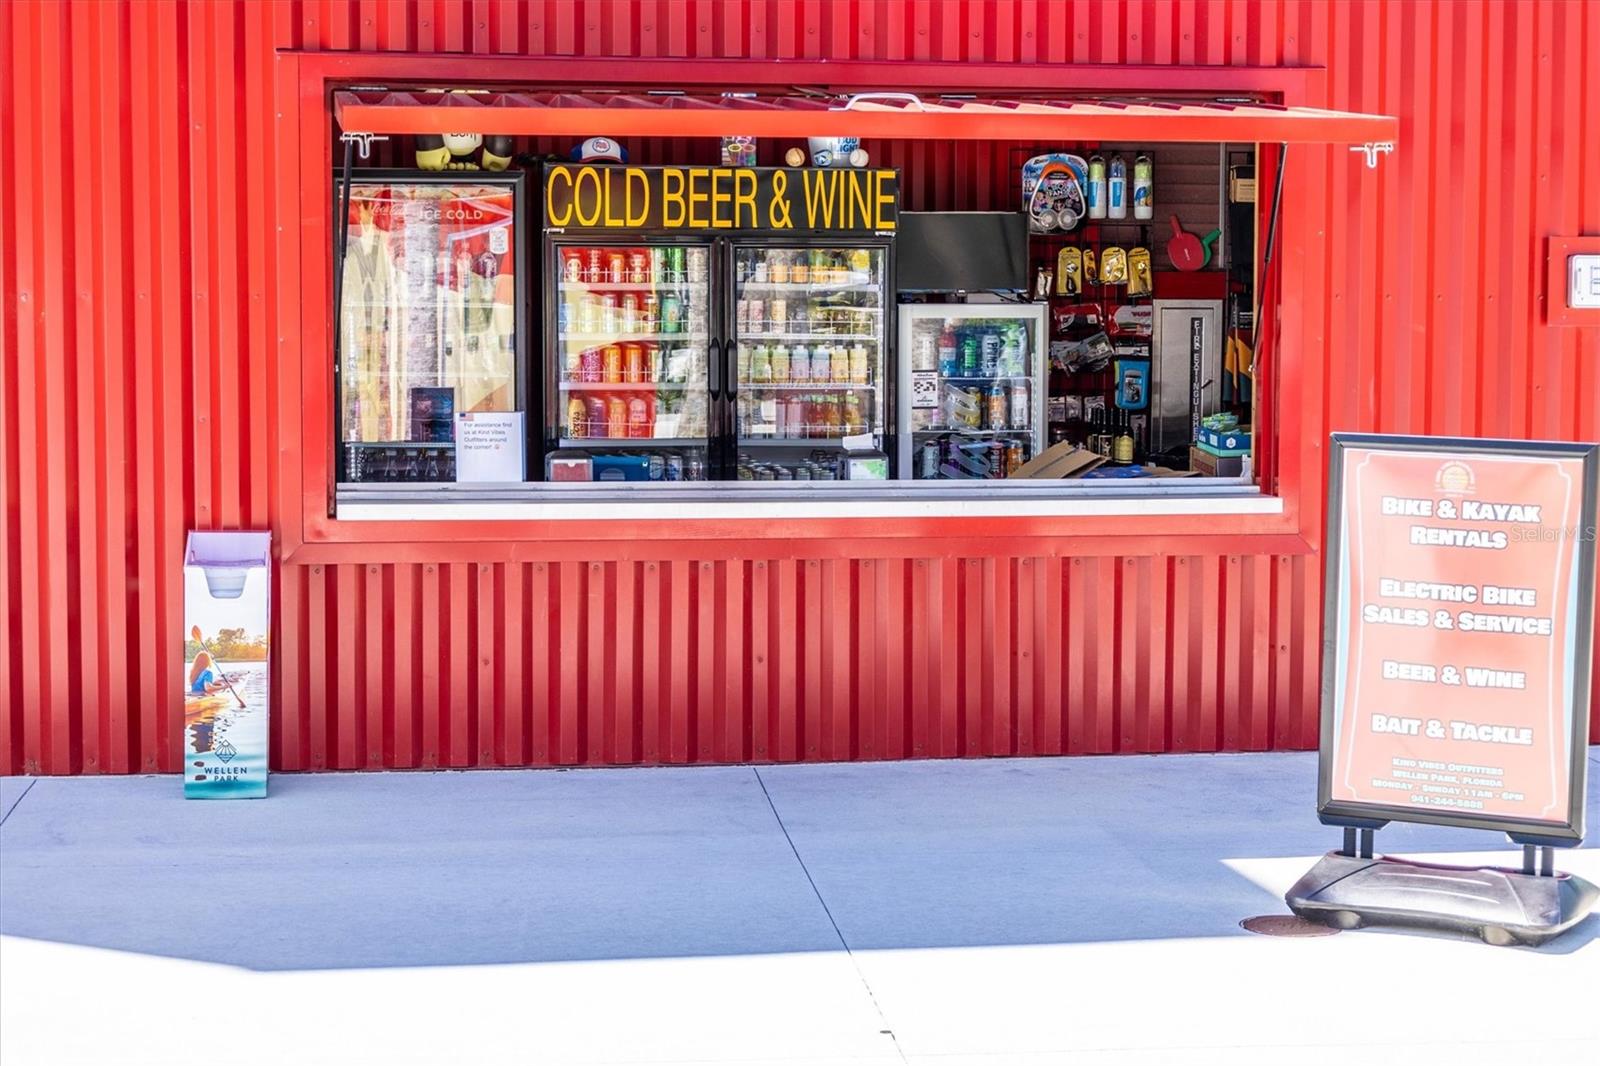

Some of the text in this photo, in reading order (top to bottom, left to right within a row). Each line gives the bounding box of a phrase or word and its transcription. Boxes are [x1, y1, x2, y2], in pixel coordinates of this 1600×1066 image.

[547, 166, 896, 230] COLD BEER & WINE
[420, 209, 483, 221] ICE COLD
[1381, 497, 1542, 523] BIKE & KAYAK
[1410, 526, 1508, 549] RENTALS
[1380, 578, 1536, 606] ELECTRIC BIKE
[1364, 605, 1552, 636] SALES & SERVICE
[1382, 660, 1526, 689] BEER & WINE
[1371, 713, 1533, 745] BAIT & TACKLE
[1392, 769, 1429, 781] WELLEN
[1462, 777, 1504, 788] FLORIDA
[1418, 760, 1445, 770] VIBES
[1447, 763, 1504, 776] OUTFITTERS
[1372, 779, 1413, 791] MONDAY
[1422, 784, 1461, 795] SUNDAY
